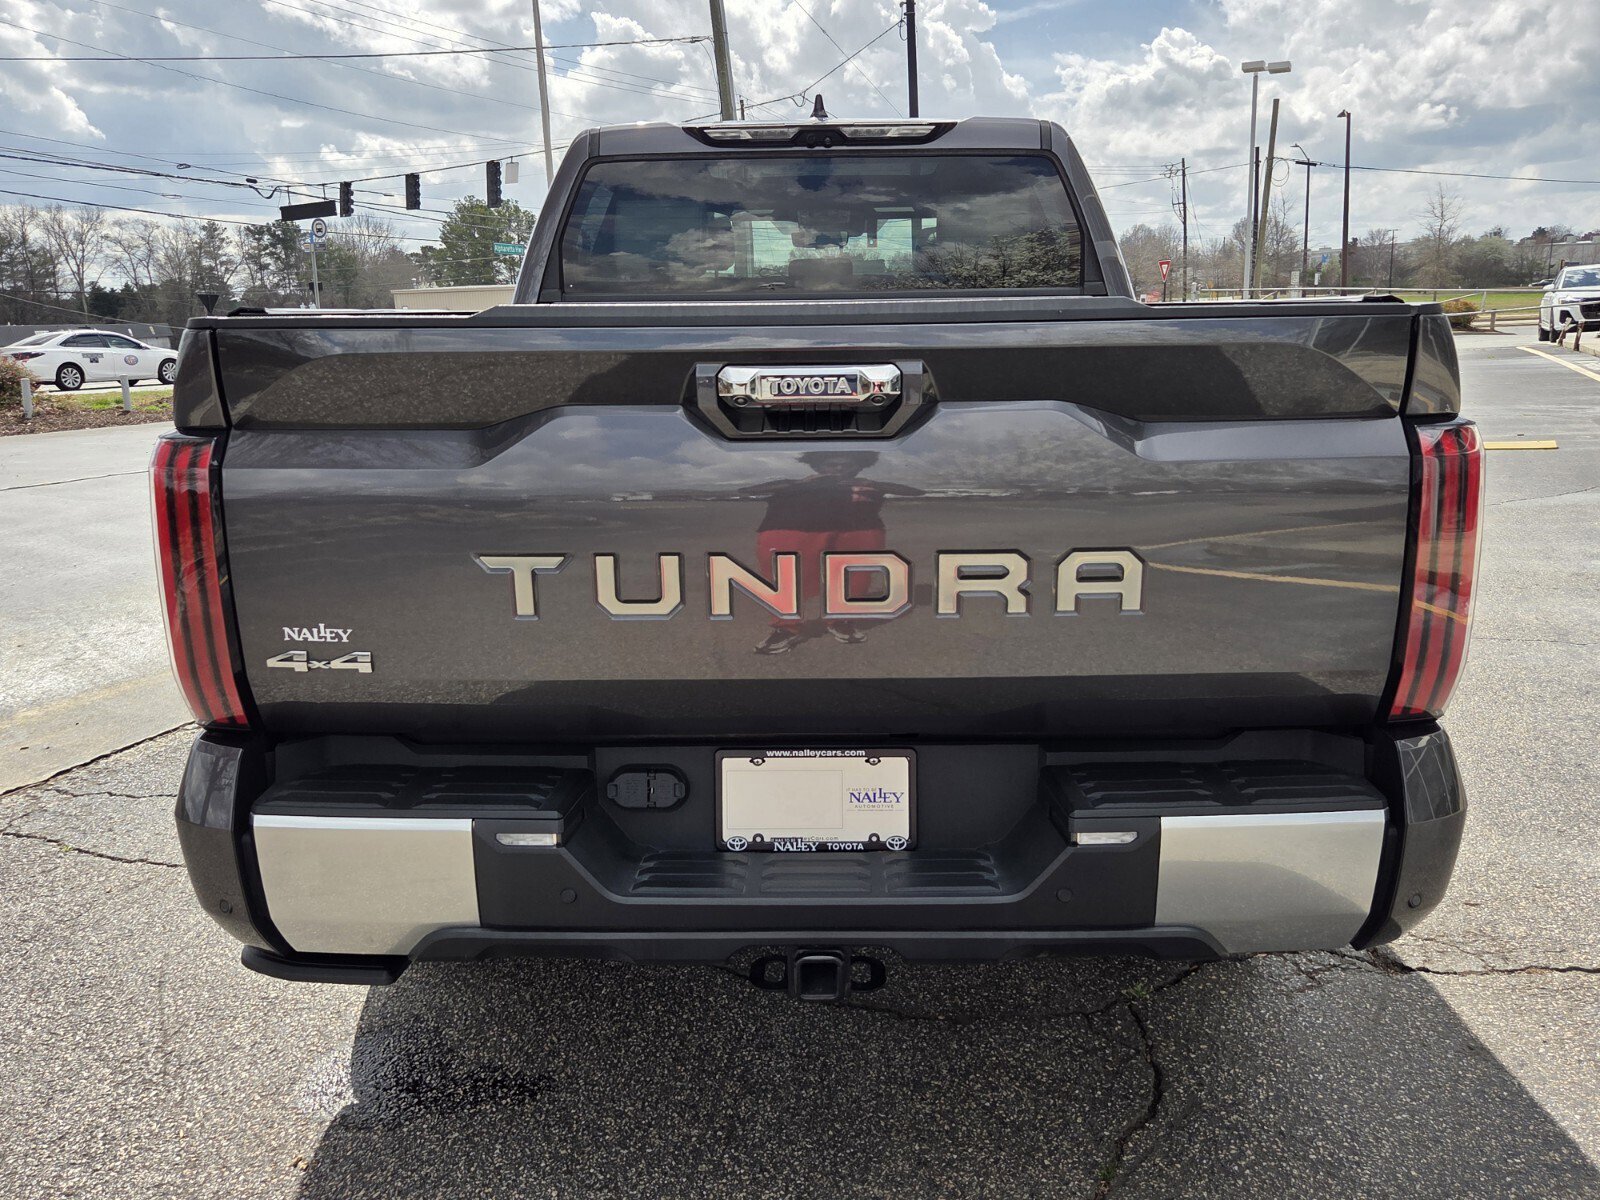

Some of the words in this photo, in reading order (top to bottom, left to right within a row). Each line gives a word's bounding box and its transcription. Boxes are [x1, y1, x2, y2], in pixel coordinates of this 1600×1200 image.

[768, 376, 852, 395] TOYOTA
[472, 548, 1146, 622] TUNDRA
[282, 623, 353, 643] NALLEY
[266, 650, 373, 674] 4x4
[766, 749, 866, 758] www.nalleycars.com
[849, 787, 904, 803] NALLEY
[773, 838, 819, 852] NALLEY
